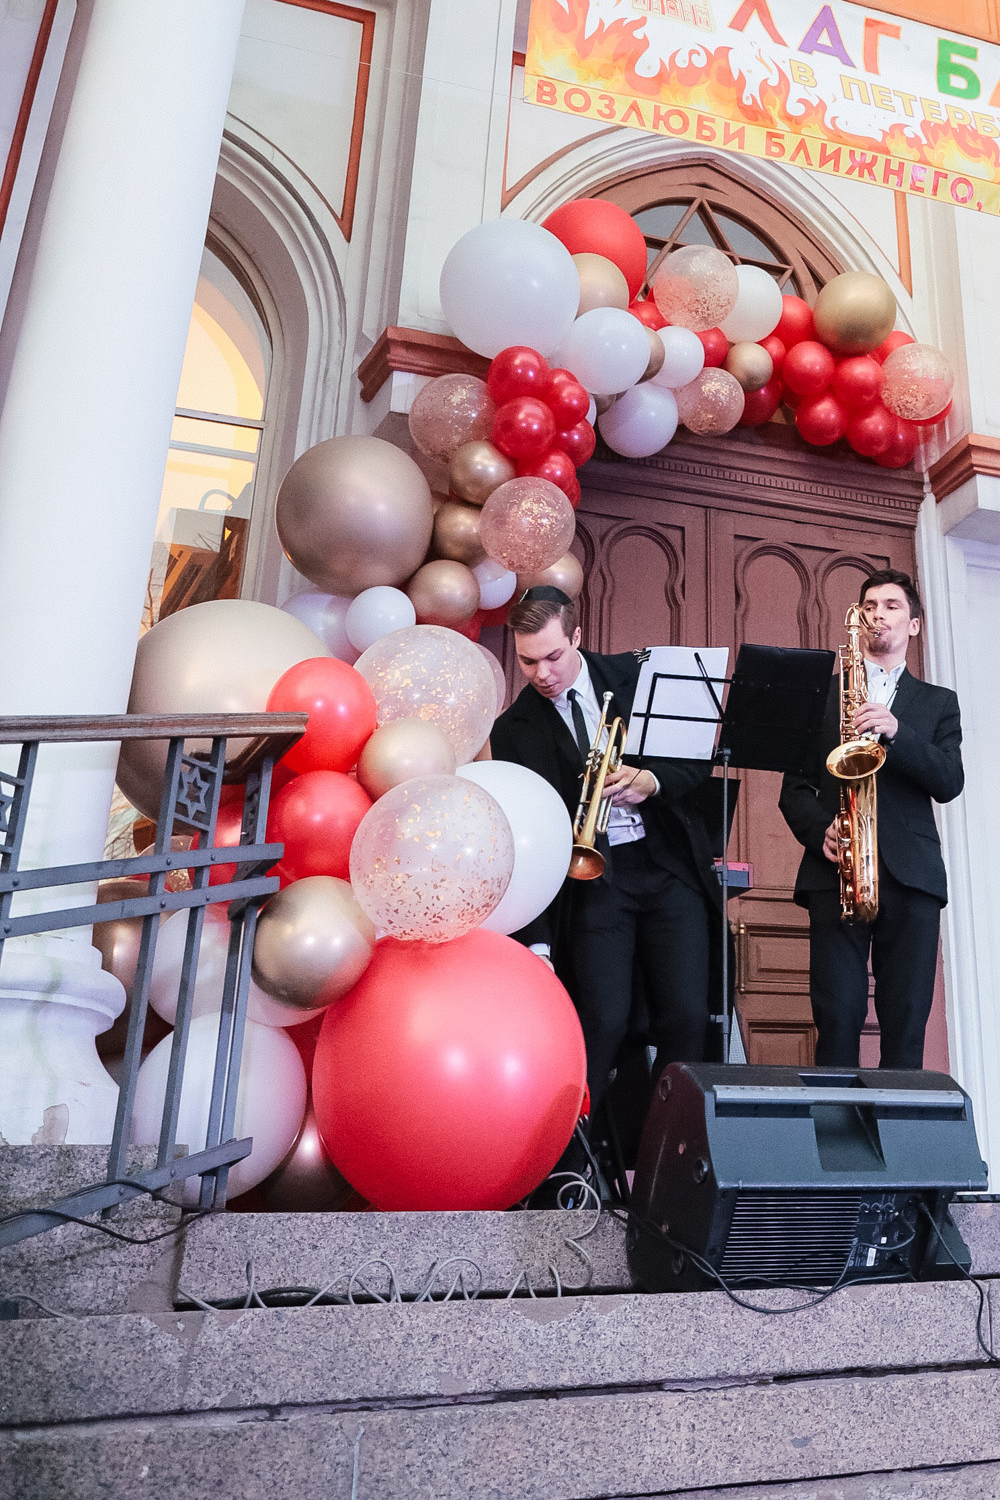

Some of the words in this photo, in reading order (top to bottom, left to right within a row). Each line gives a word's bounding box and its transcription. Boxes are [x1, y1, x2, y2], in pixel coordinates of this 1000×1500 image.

[789, 59, 818, 88] В
[535, 79, 746, 151] ВОЗЛЮБИ
[764, 130, 984, 212] БЛИЖНЕГО,
